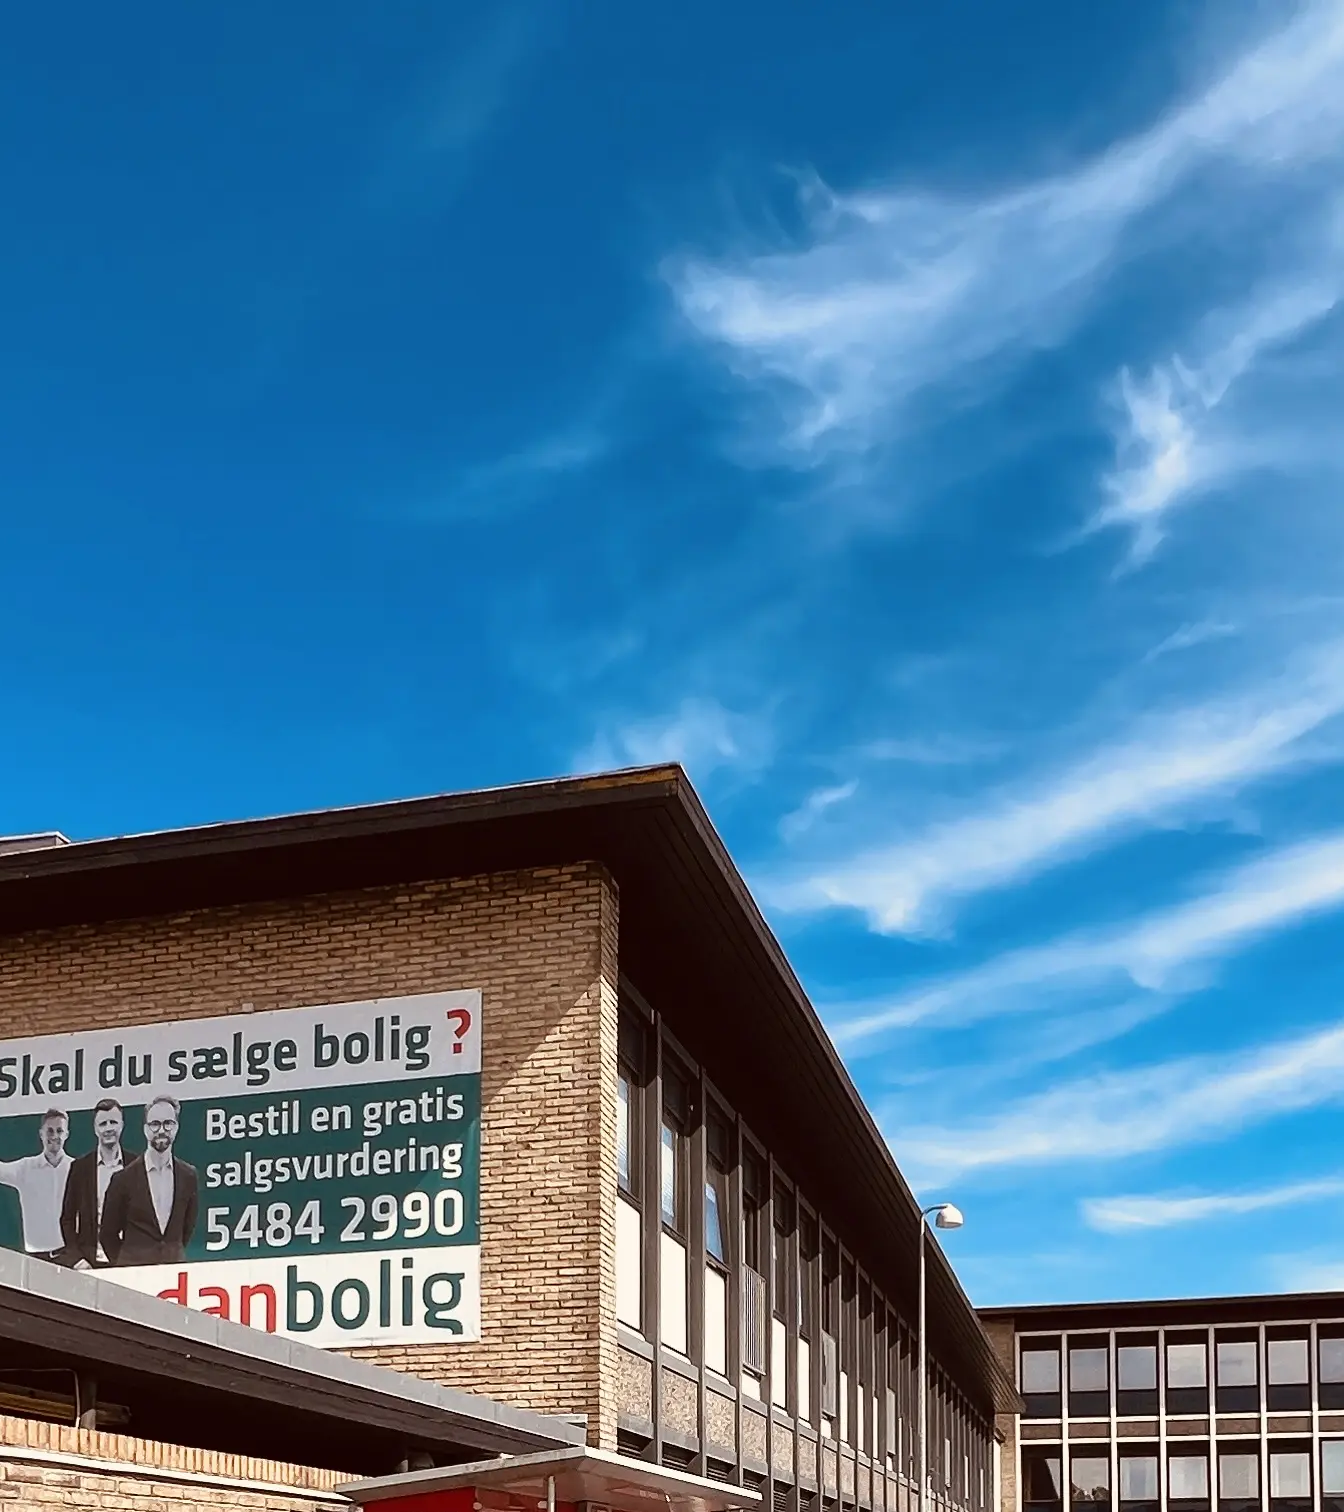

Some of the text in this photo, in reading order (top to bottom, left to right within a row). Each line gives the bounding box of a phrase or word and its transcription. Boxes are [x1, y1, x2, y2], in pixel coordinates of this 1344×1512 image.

[98, 1044, 153, 1090] du
[168, 1031, 298, 1086] sælge
[313, 1015, 432, 1071] bolig
[446, 1008, 472, 1054] ?
[206, 1089, 464, 1142] Bestil en gratis
[205, 1140, 464, 1193] salgsvurdering
[205, 1189, 464, 1252] 5484 2990
